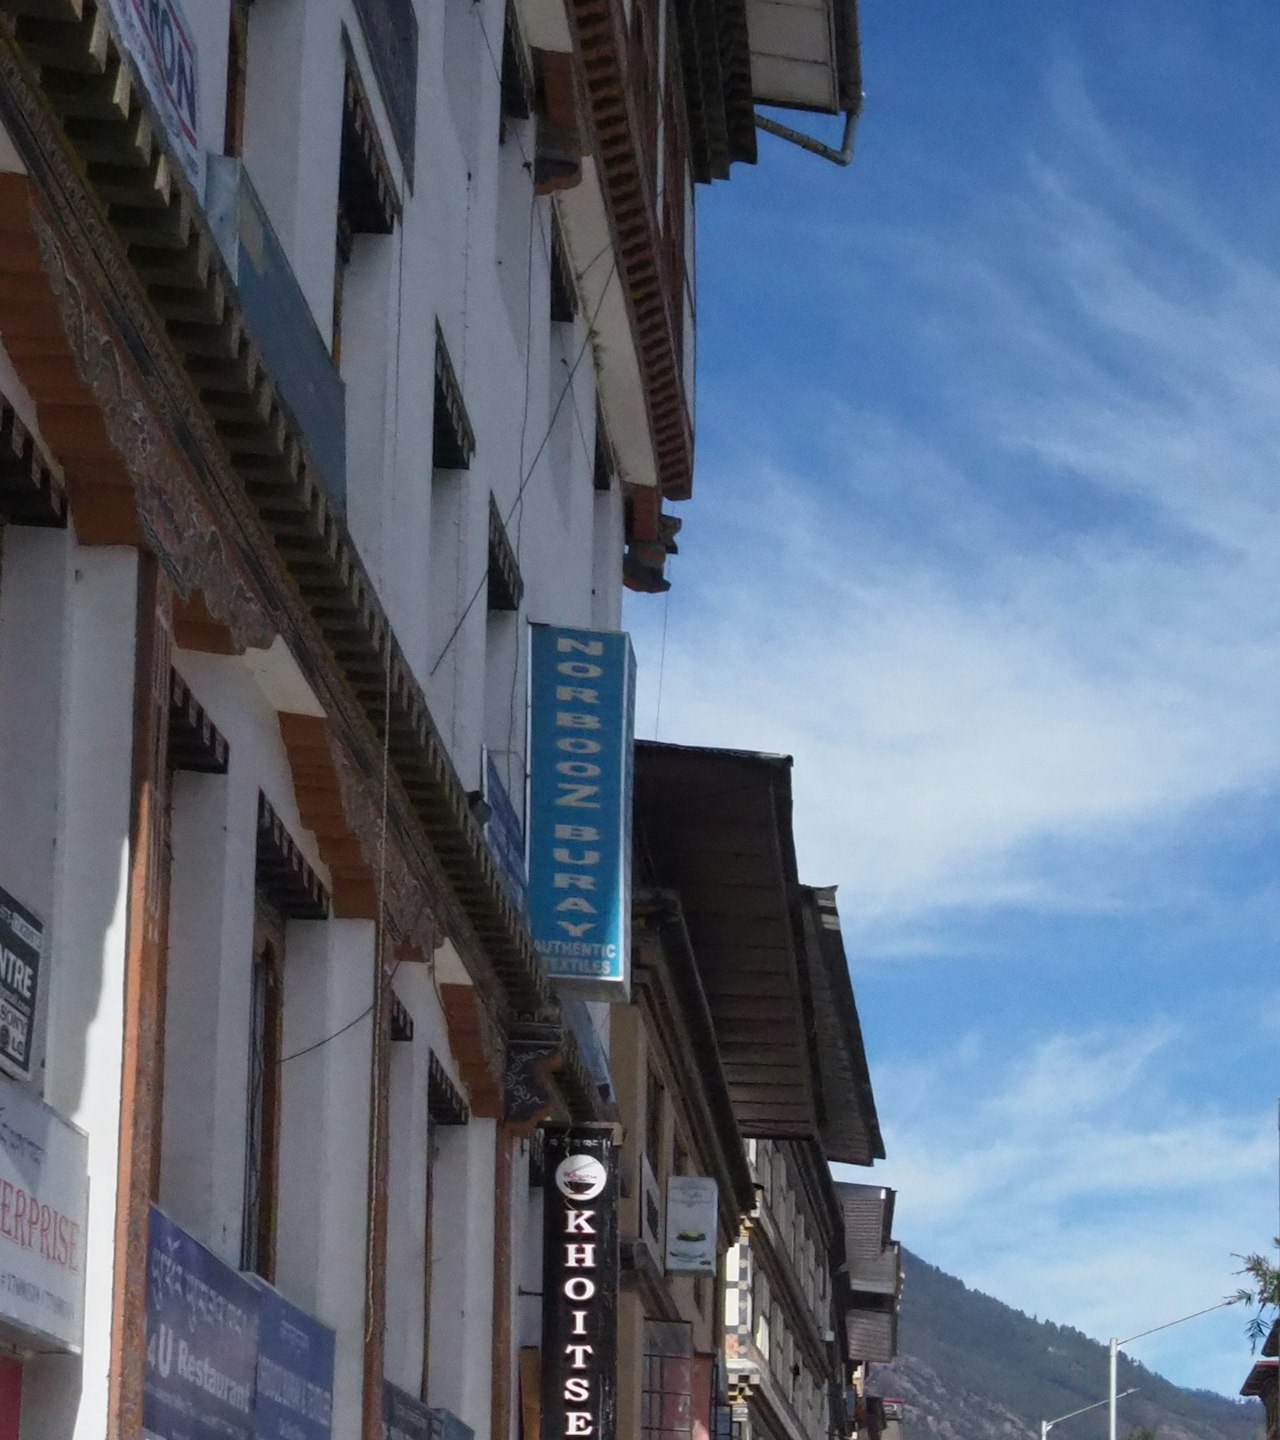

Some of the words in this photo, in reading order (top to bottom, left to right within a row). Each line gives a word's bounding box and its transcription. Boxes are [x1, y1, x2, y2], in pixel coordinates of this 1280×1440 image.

[555, 637, 603, 809] NORBOOZ
[554, 823, 600, 938] BURAY
[534, 939, 617, 960] AUTHENTIC
[542, 956, 611, 976] TEXTILES
[564, 1209, 596, 1436] KHOITSE
